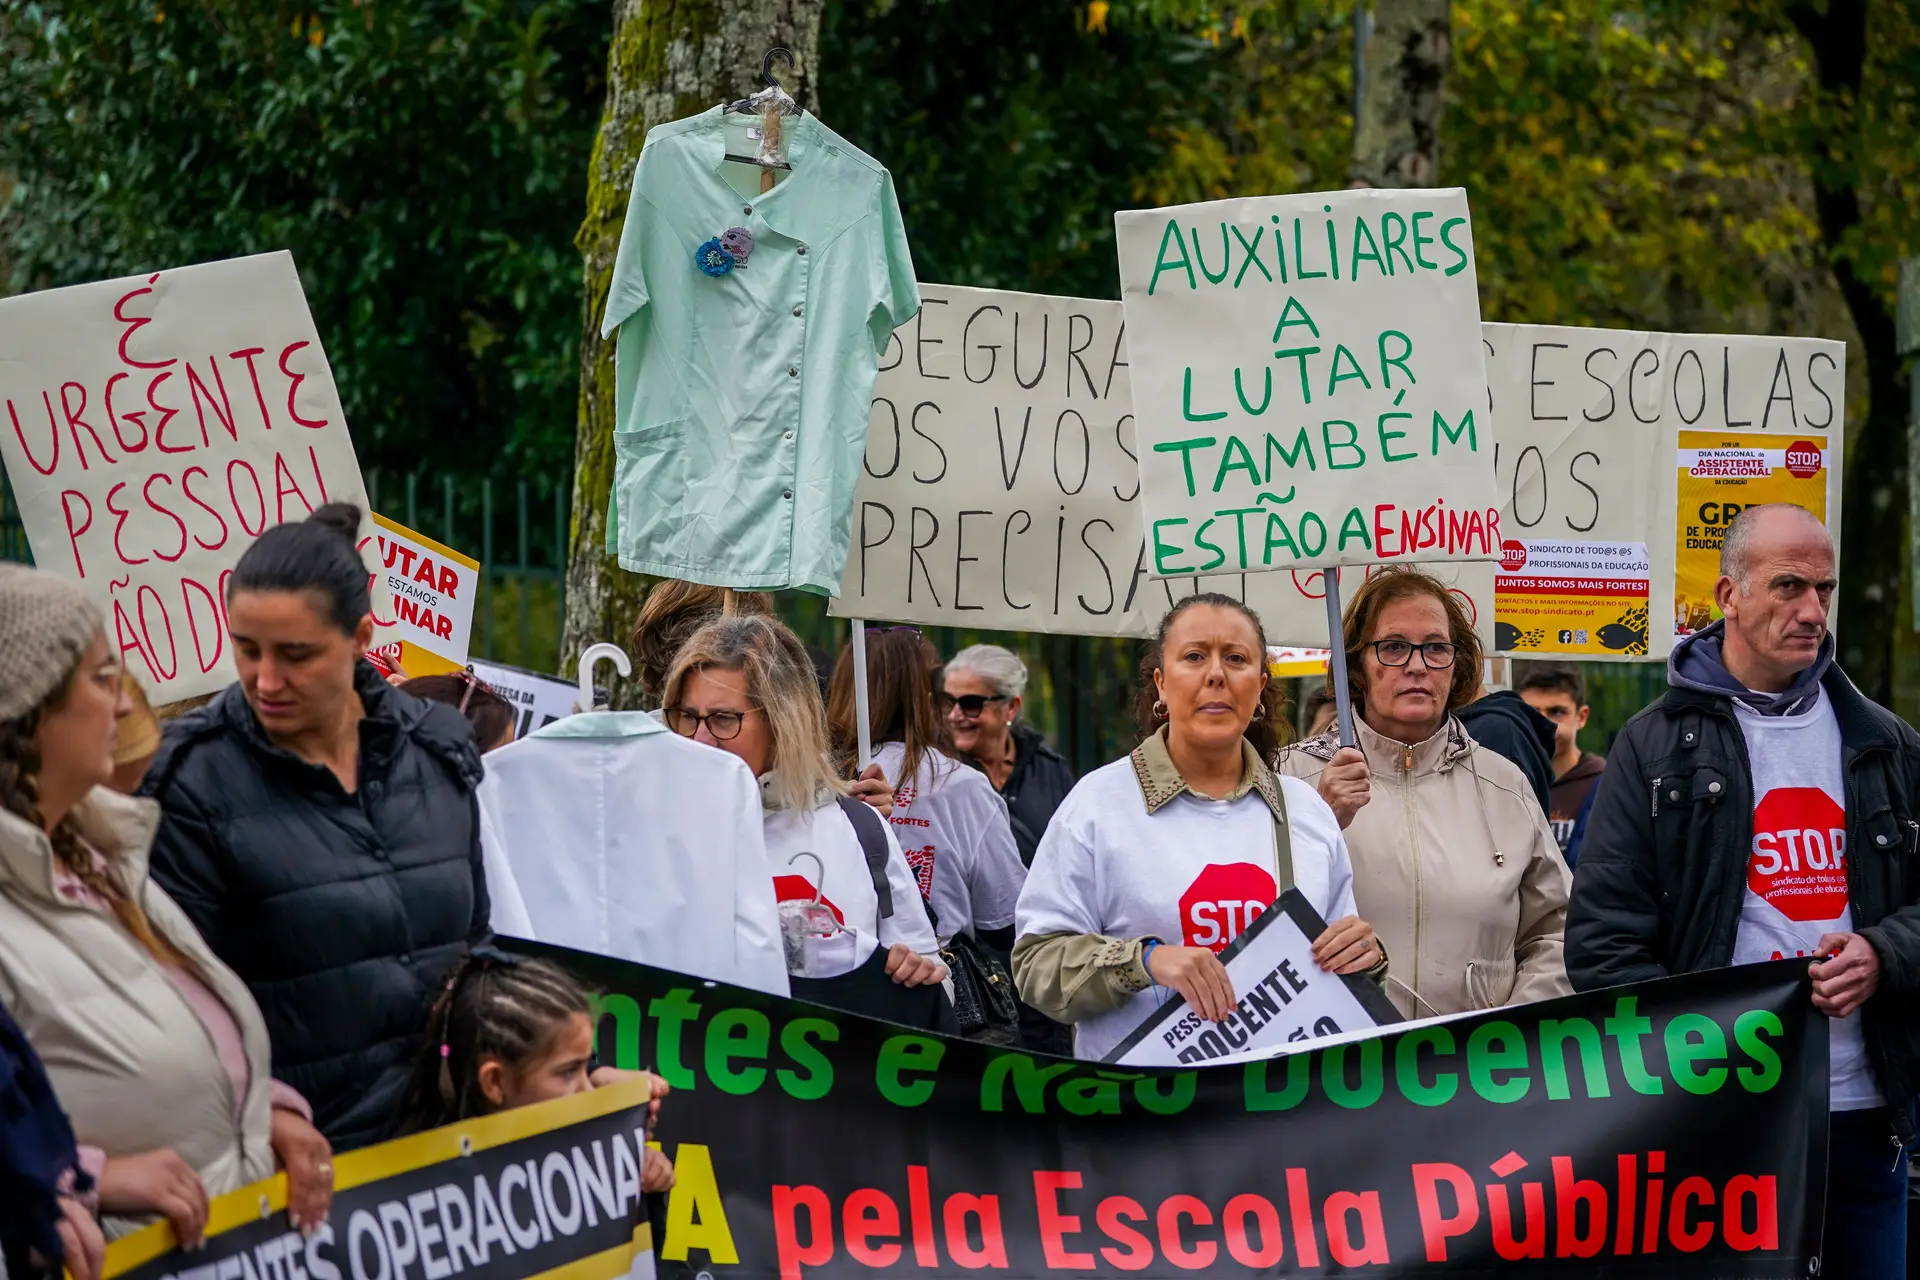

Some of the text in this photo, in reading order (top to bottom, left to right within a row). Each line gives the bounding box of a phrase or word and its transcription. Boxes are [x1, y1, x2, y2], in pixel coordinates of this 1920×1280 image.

[113, 273, 178, 369] É
[1272, 295, 1320, 344] A
[1183, 329, 1417, 423] LUTAR
[1530, 342, 1837, 429] ESCOLAS
[7, 341, 328, 476] URGENTE
[863, 397, 947, 484] OS
[994, 406, 1140, 502] VOS
[1153, 388, 1478, 497] TAMBÉM
[1698, 450, 1712, 458] DIA
[1714, 450, 1755, 458] NACIONAL
[1690, 467, 1772, 476] OPERACIONAL
[1697, 459, 1764, 468] ASSISTENTE
[1722, 478, 1748, 486] EDUCAÇÃO
[1153, 485, 1503, 575] ESTÃO A ENSINAR
[1686, 527, 1699, 537] DE
[1529, 545, 1632, 556] SINDICATO DE TOD@S @S
[1529, 560, 1589, 570] PROFISSIONAIS
[1591, 561, 1603, 570] DA
[1605, 561, 1649, 571] EDUCAÇÃO
[378, 535, 459, 600] UTAR
[388, 576, 438, 607] ESTAMOS
[1497, 578, 1647, 590] JUNTOS SOMOS MAIS FORTES!
[1495, 607, 1595, 617] www.stop-sindicato.pt
[1558, 599, 1605, 607] INFORMAÇÕES
[110, 575, 178, 684] ÃO
[890, 817, 930, 827] FORTES
[1765, 886, 1813, 900] profissionais
[1771, 876, 1806, 888] sindicato
[1806, 875, 1816, 884] de
[1177, 958, 1309, 1065] DOCENTE
[876, 1033, 946, 1106] e
[1243, 996, 1785, 1112] Docentes
[772, 1165, 1009, 1280] pela
[1033, 1167, 1391, 1271] Escola
[1411, 1150, 1779, 1263] Pública
